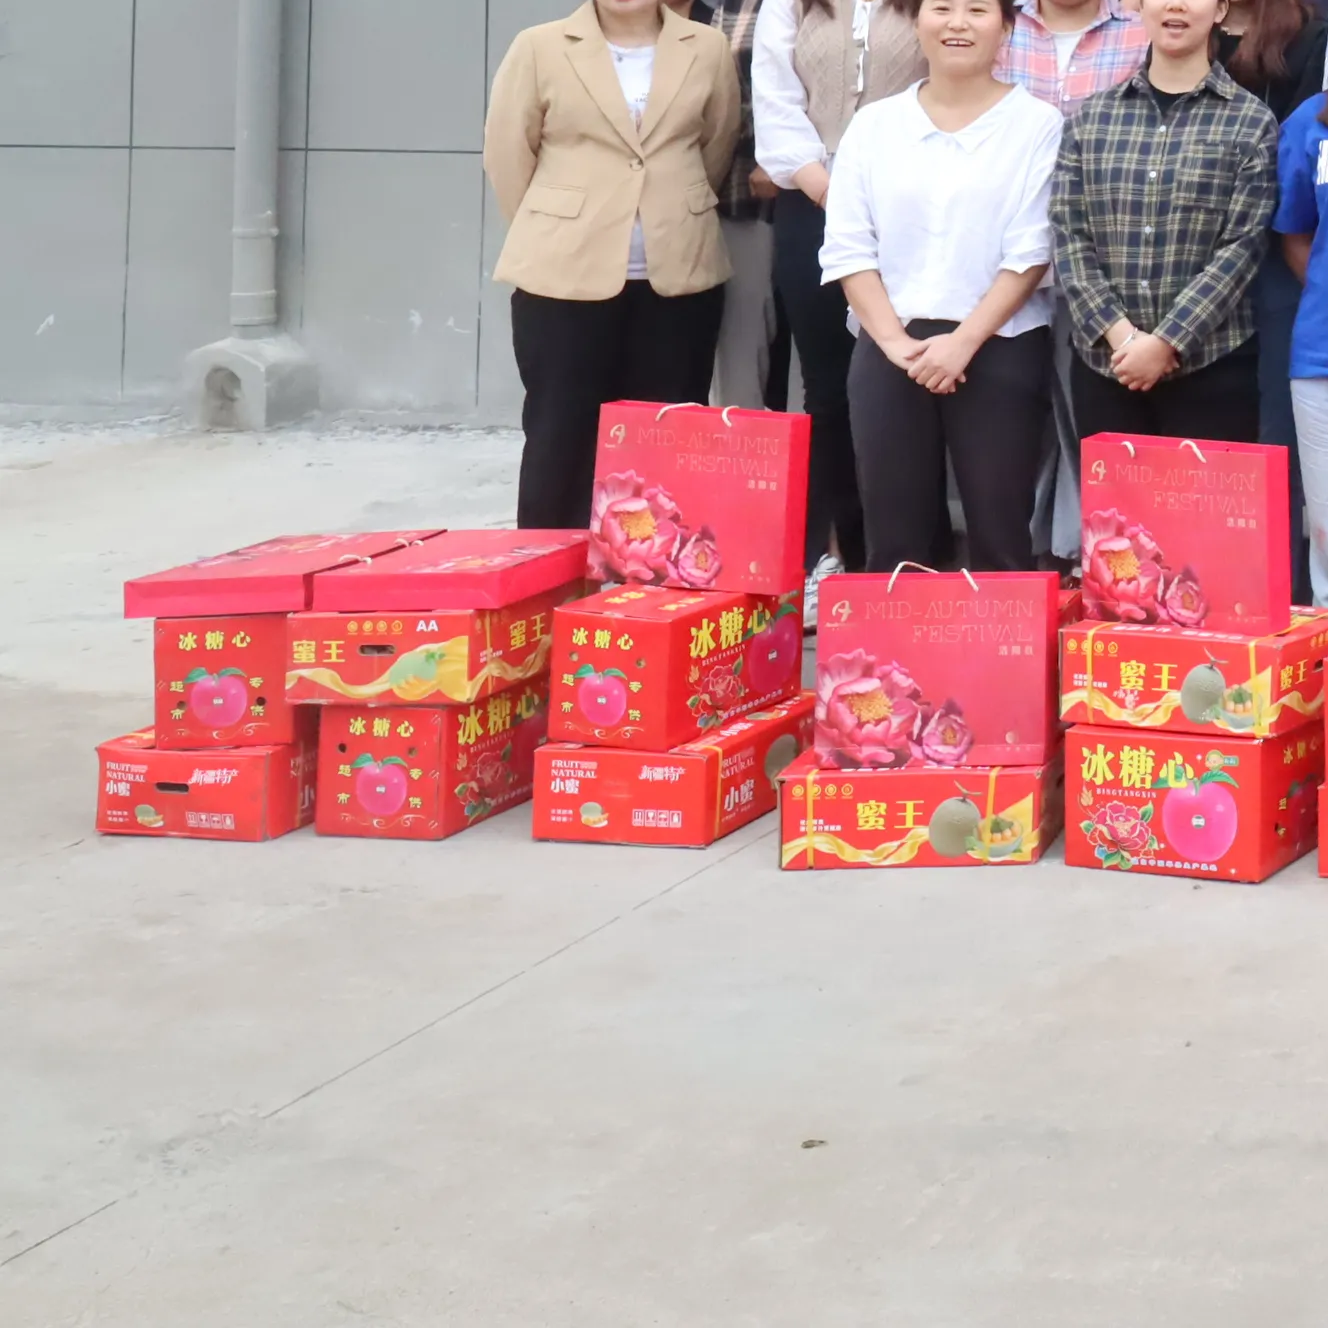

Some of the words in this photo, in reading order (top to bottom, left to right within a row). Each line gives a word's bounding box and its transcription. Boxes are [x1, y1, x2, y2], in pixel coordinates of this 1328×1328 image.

[637, 427, 779, 455] MID-AUTUMN
[676, 454, 777, 477] FESTIVAL
[1114, 463, 1256, 492] MID-AUTUMN
[1153, 491, 1255, 515] FESTIVAL
[865, 600, 1033, 620] MID-AUTUMN
[416, 620, 439, 632] AA
[689, 602, 771, 659] 冰糖心
[912, 625, 1033, 643] FESTIVAL
[178, 630, 251, 651] 冰糖心
[571, 627, 634, 651] 冰糖心
[292, 639, 345, 663] 蜜王
[1119, 660, 1179, 692] 蜜王
[457, 685, 540, 746] 冰糖心
[349, 717, 414, 738] 冰糖心
[106, 761, 131, 772] FRUIT
[551, 760, 581, 769] FRUIT
[551, 769, 598, 779] NATURAL
[1080, 743, 1194, 789] 冰糖心
[106, 771, 145, 783] NATURAL
[550, 779, 580, 794] 小蜜
[856, 800, 925, 830] 蜜王
